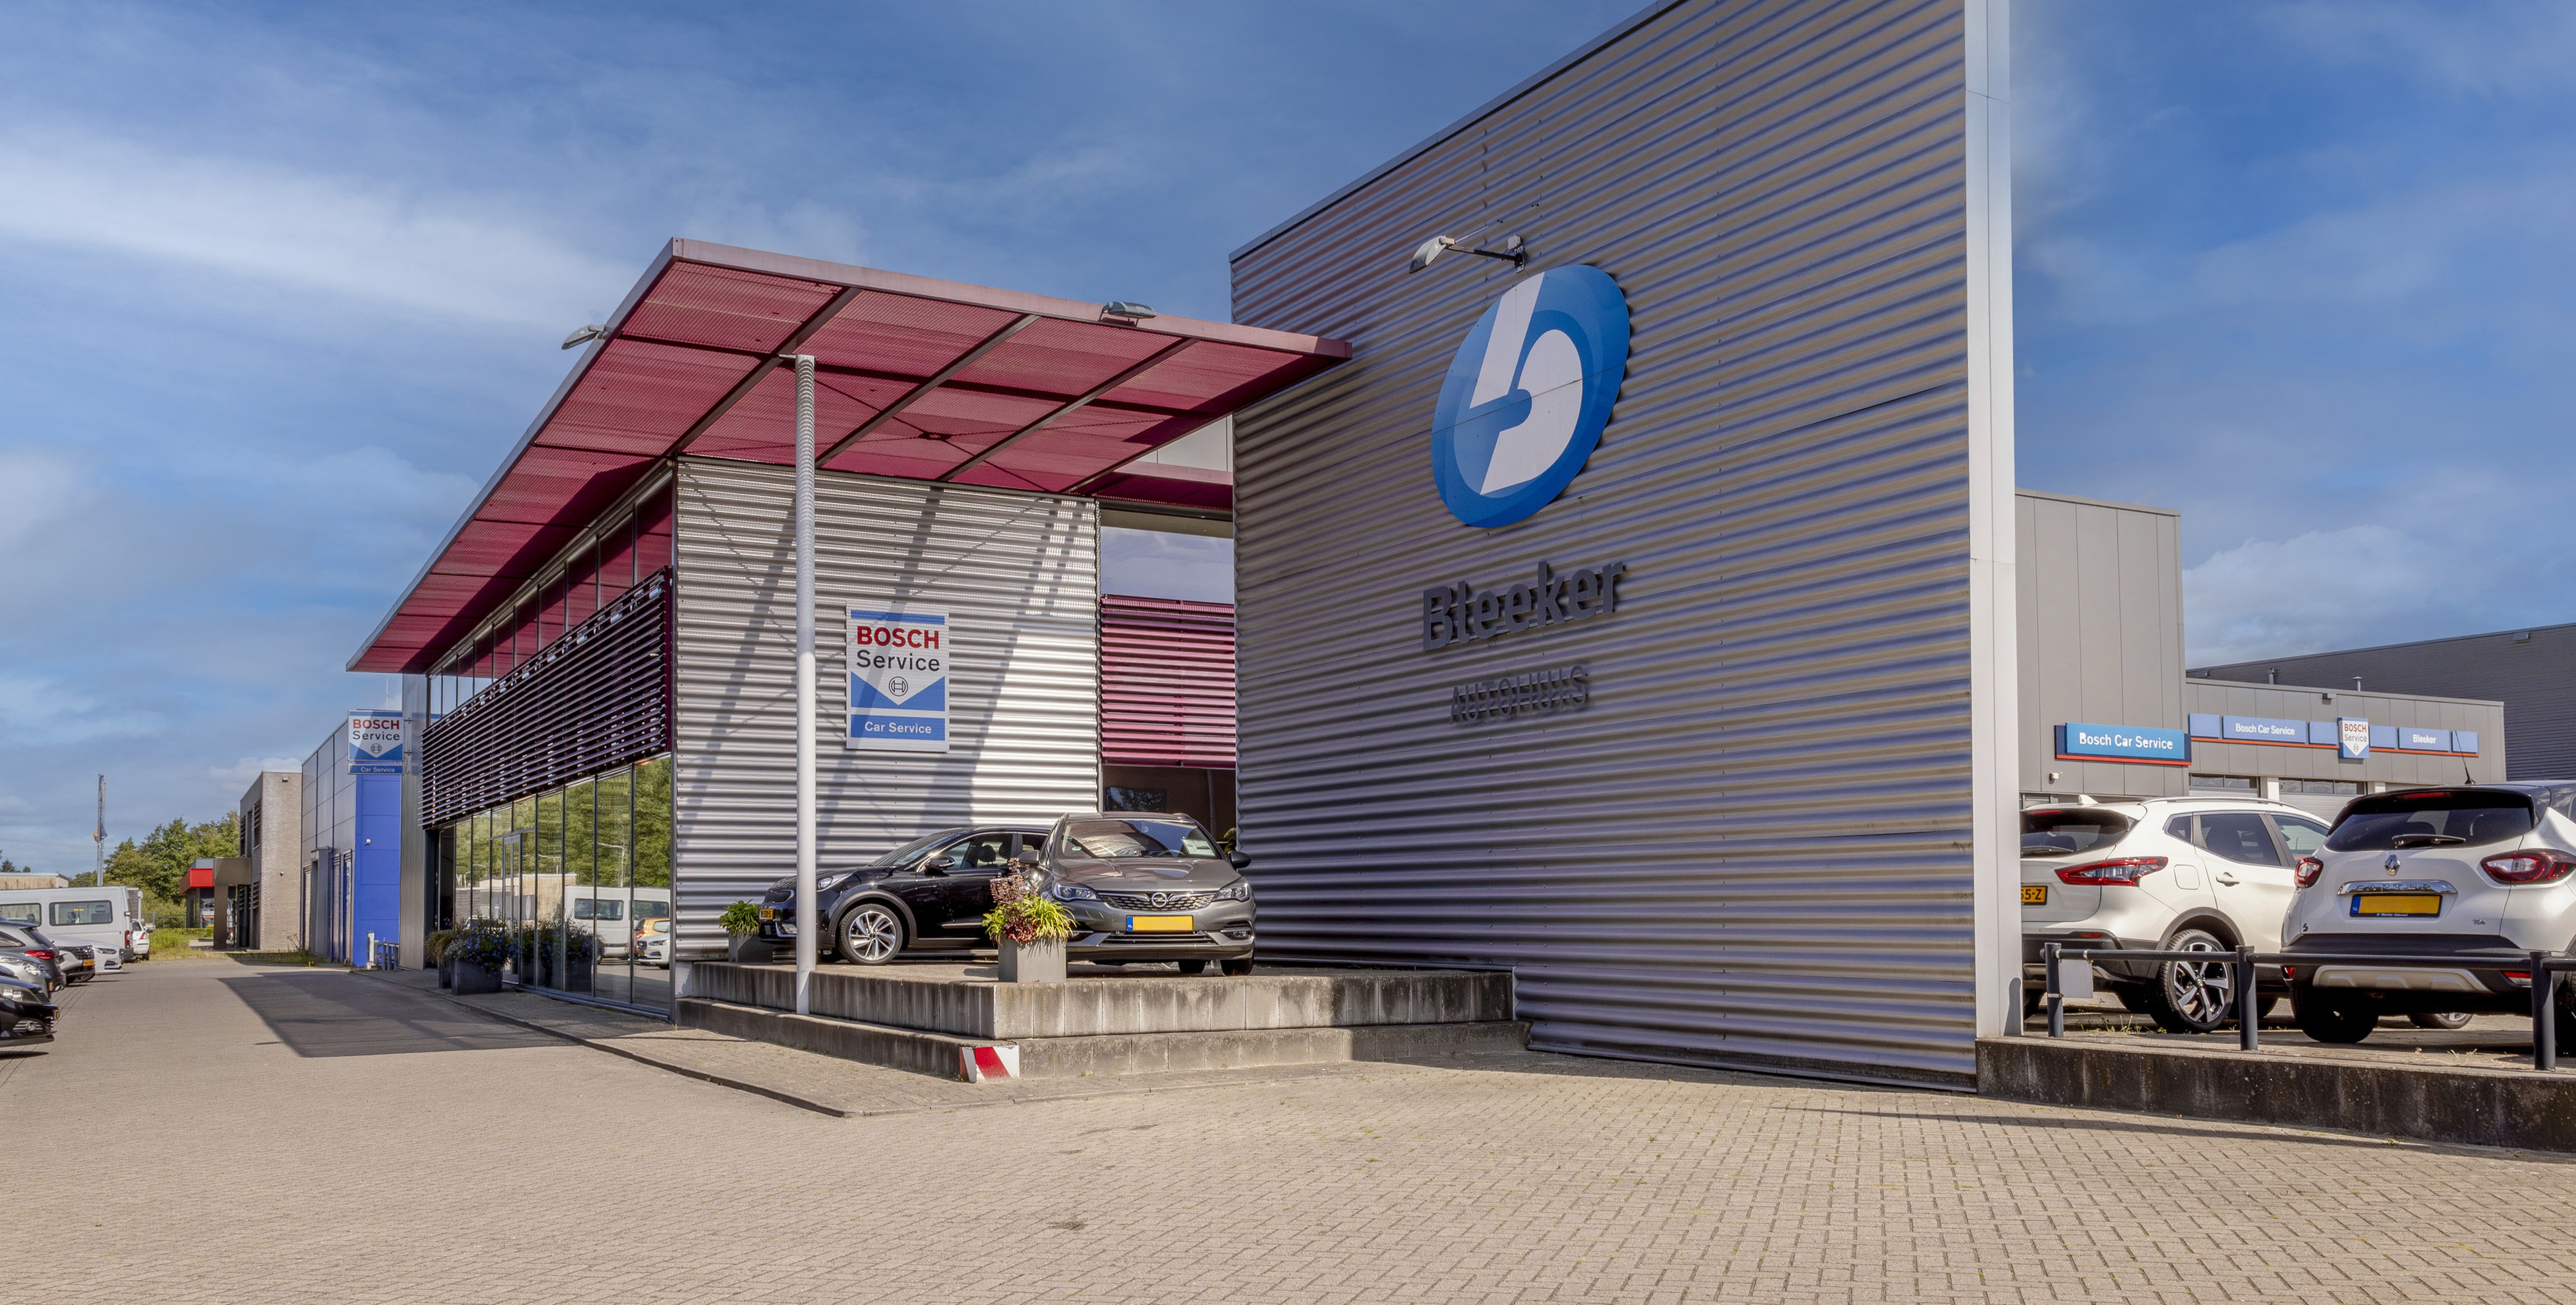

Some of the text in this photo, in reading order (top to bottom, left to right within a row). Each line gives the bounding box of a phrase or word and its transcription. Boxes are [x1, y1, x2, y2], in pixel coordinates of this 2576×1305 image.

[1423, 558, 1624, 651] Bleeker
[857, 625, 940, 649] BOSCH
[856, 649, 940, 672] Service
[1449, 665, 1588, 725] AUTOHUIS
[352, 719, 400, 730] BOSCH
[864, 721, 932, 734] Car Service
[2235, 723, 2295, 735] Bosch Car Service
[2344, 723, 2367, 732] BOSCH
[352, 730, 400, 741] Service
[2079, 732, 2174, 750] Bosch Car Service
[2344, 734, 2367, 742] Service
[2412, 734, 2436, 744] Bleeker
